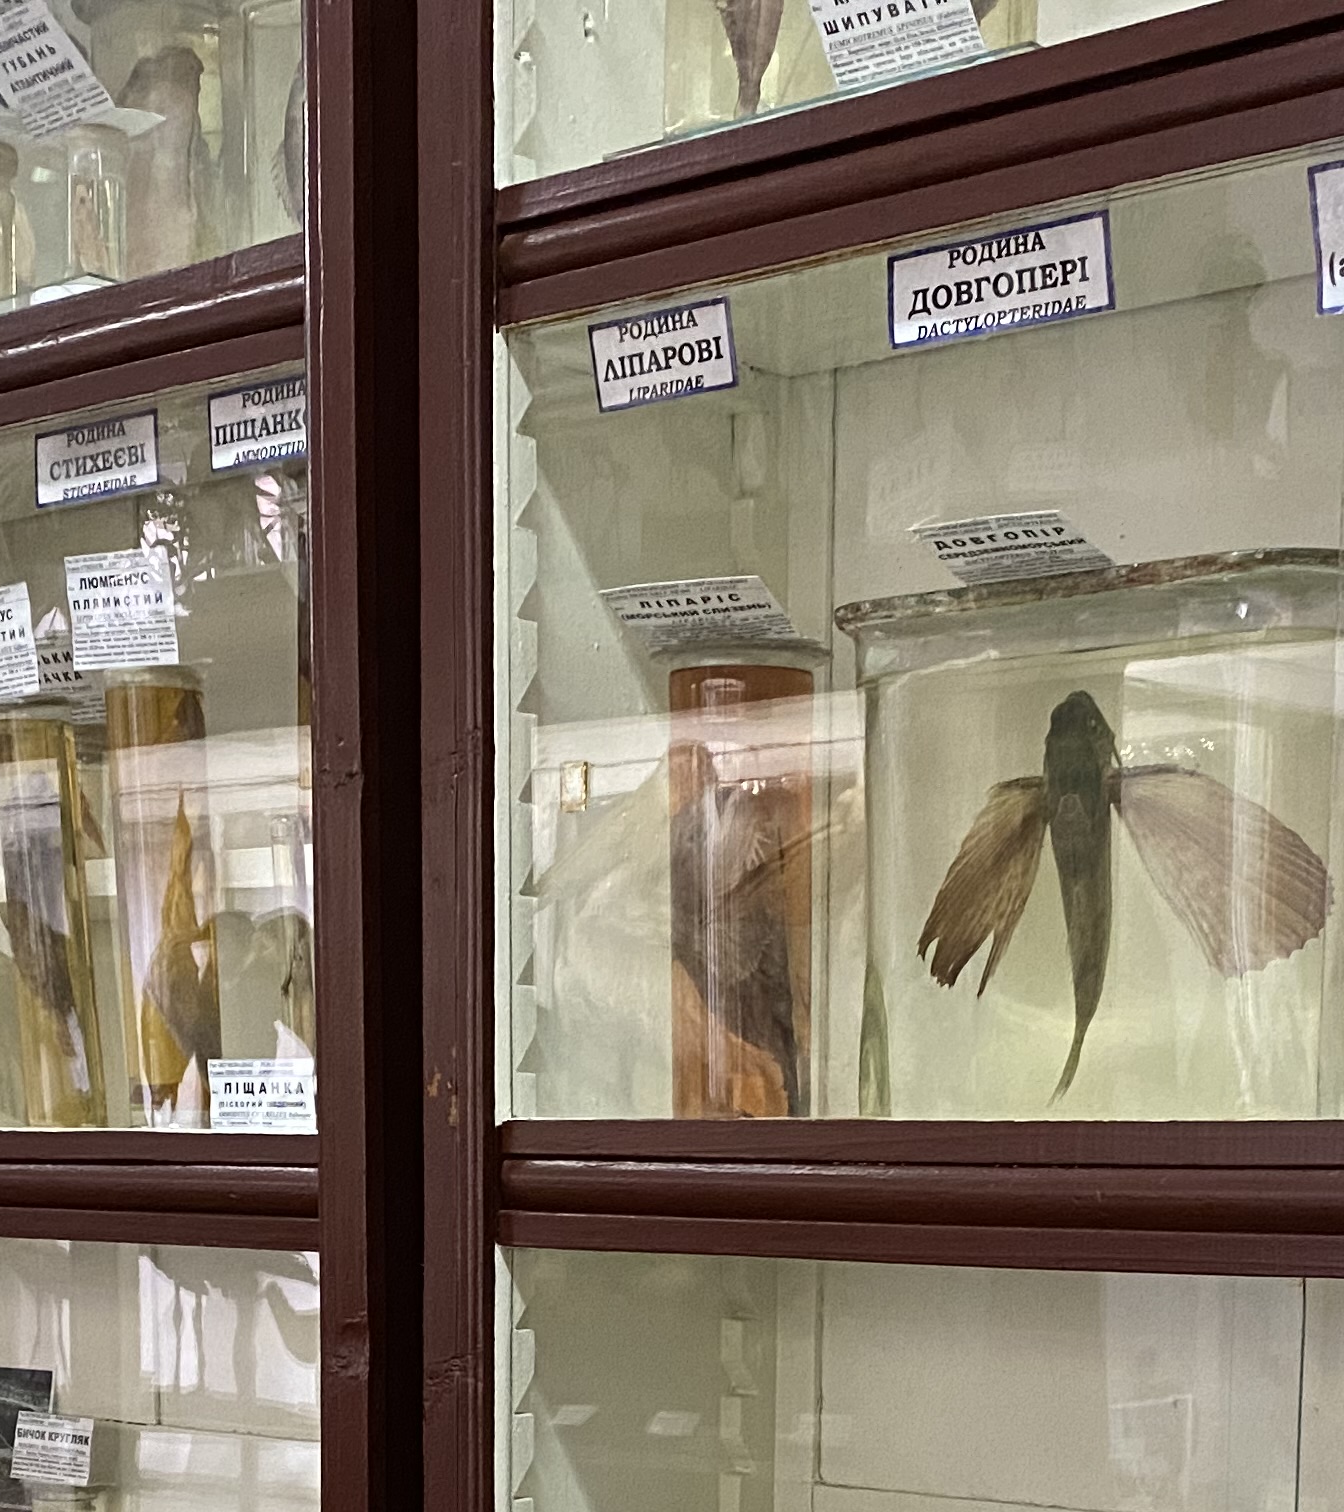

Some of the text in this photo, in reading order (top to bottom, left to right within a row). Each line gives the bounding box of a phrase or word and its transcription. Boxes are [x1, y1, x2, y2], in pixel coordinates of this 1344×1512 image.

[2, 43, 56, 74] ГУБАНЬ
[946, 229, 1046, 270] РОДИНА
[908, 257, 1090, 319] ДОВГОПЕРІ
[617, 308, 698, 342] РОДИНА
[917, 295, 1087, 341] DACTYLOPTERIDAE
[603, 336, 724, 383] ЛІПАРОВІ
[242, 379, 307, 409] РОДИНА
[628, 375, 704, 403] LIPARIDAE
[67, 421, 126, 448] РОДИНА
[214, 408, 304, 447] ПІЩАНК
[50, 443, 146, 481] СТИХЕЄВІ
[234, 440, 305, 465] AMMODYTID
[934, 526, 1066, 551] ДОВГОПІР
[79, 572, 149, 590] ЛЮМПЕНУС
[73, 592, 164, 611] ПЛЯМИСТИЙ
[224, 1082, 304, 1097] ПІЩАНКА
[17, 1427, 91, 1446] БИЧОК КРУГЛЯК
